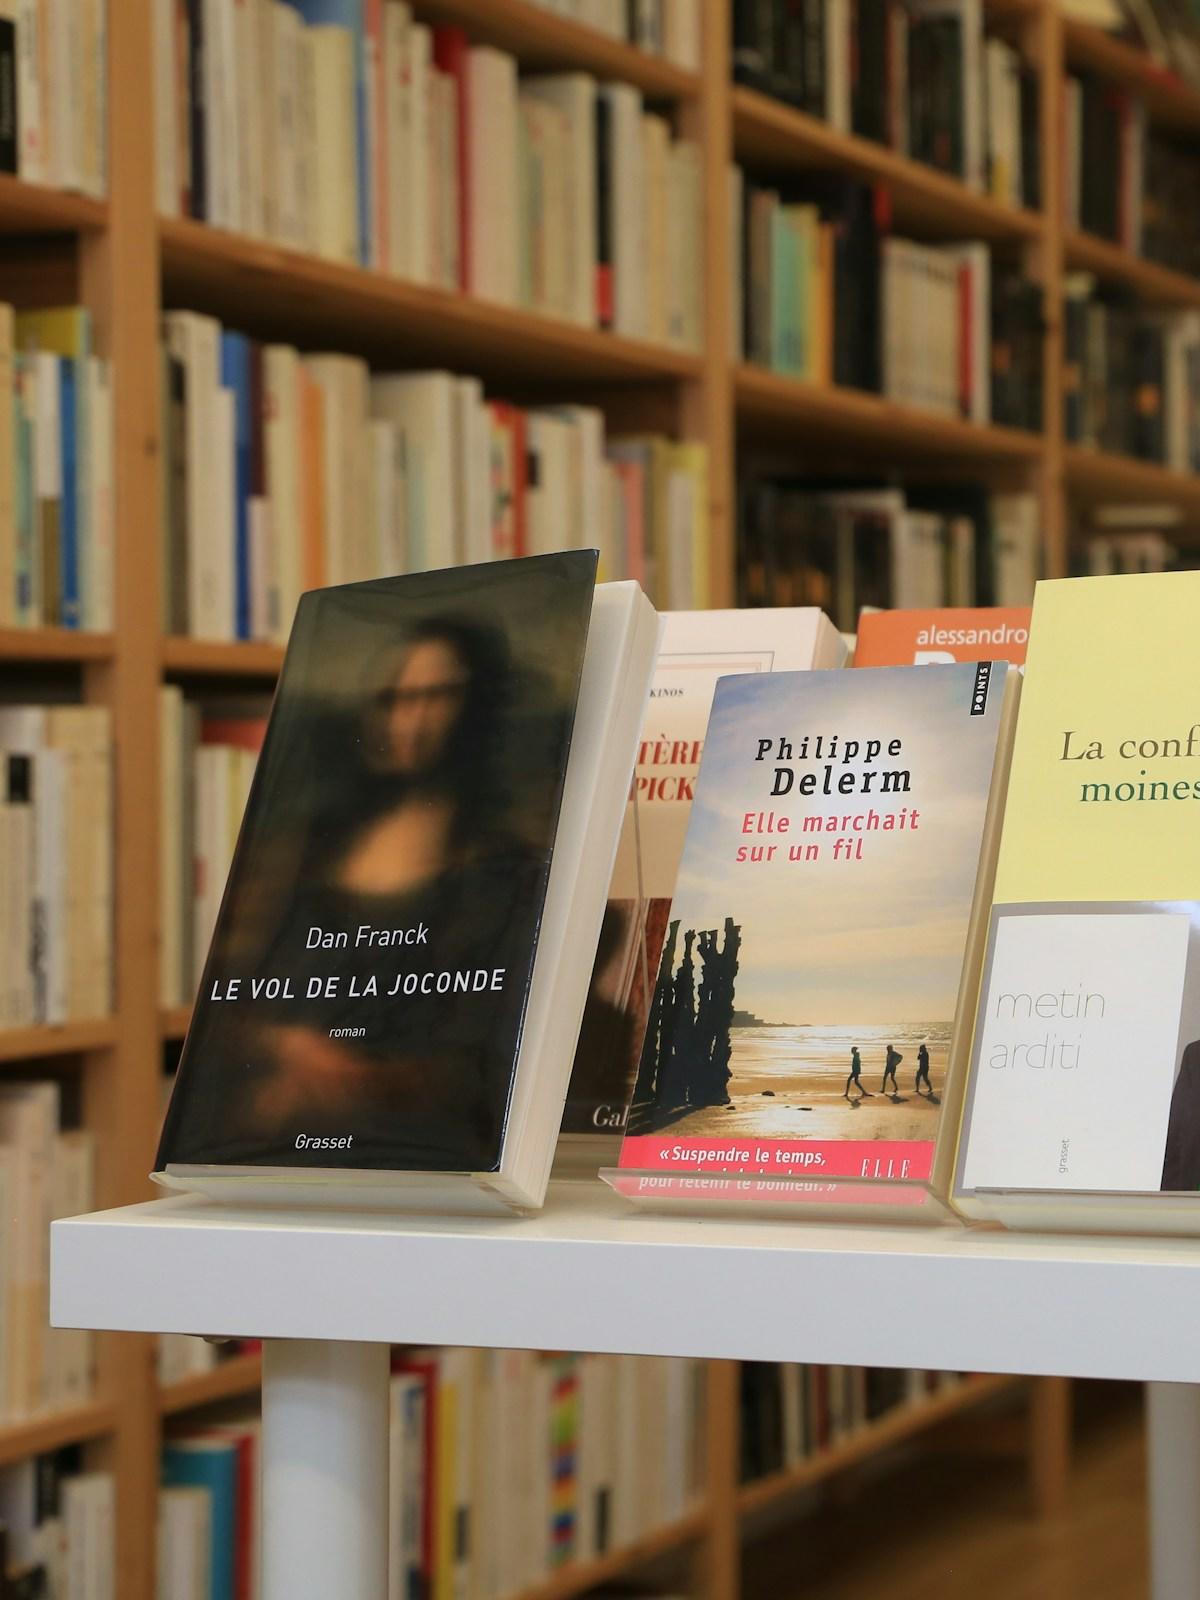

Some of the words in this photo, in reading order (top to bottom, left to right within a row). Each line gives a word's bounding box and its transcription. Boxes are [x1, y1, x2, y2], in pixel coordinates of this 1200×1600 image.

[916, 624, 1028, 646] alessandro
[649, 687, 685, 698] KINOS
[974, 667, 989, 712] POINTS
[637, 734, 704, 766] TÈR
[755, 735, 903, 764] Philippe
[1059, 731, 1106, 761] La
[770, 765, 912, 796] Delerm
[742, 812, 790, 834] Elle
[802, 808, 921, 832] marchait
[736, 845, 777, 862] sur
[788, 844, 820, 862] un
[833, 838, 863, 860] fil
[305, 926, 349, 949] Dan
[354, 922, 430, 948] Franck
[210, 979, 242, 1001] LE
[250, 978, 296, 999] VOL
[305, 976, 341, 999] DE
[348, 975, 379, 997] LA
[387, 968, 507, 996] JOCONDE
[995, 983, 1106, 1018] metin
[328, 1025, 366, 1039] roman
[989, 1033, 1083, 1069] arditi
[592, 1104, 628, 1128] Gal
[295, 1133, 353, 1149] Grasset
[672, 1146, 750, 1166] Suspendre
[755, 1147, 770, 1163] le
[775, 1149, 827, 1167] temps,
[861, 1158, 911, 1179] ELLE
[1058, 1138, 1071, 1174] grasset
